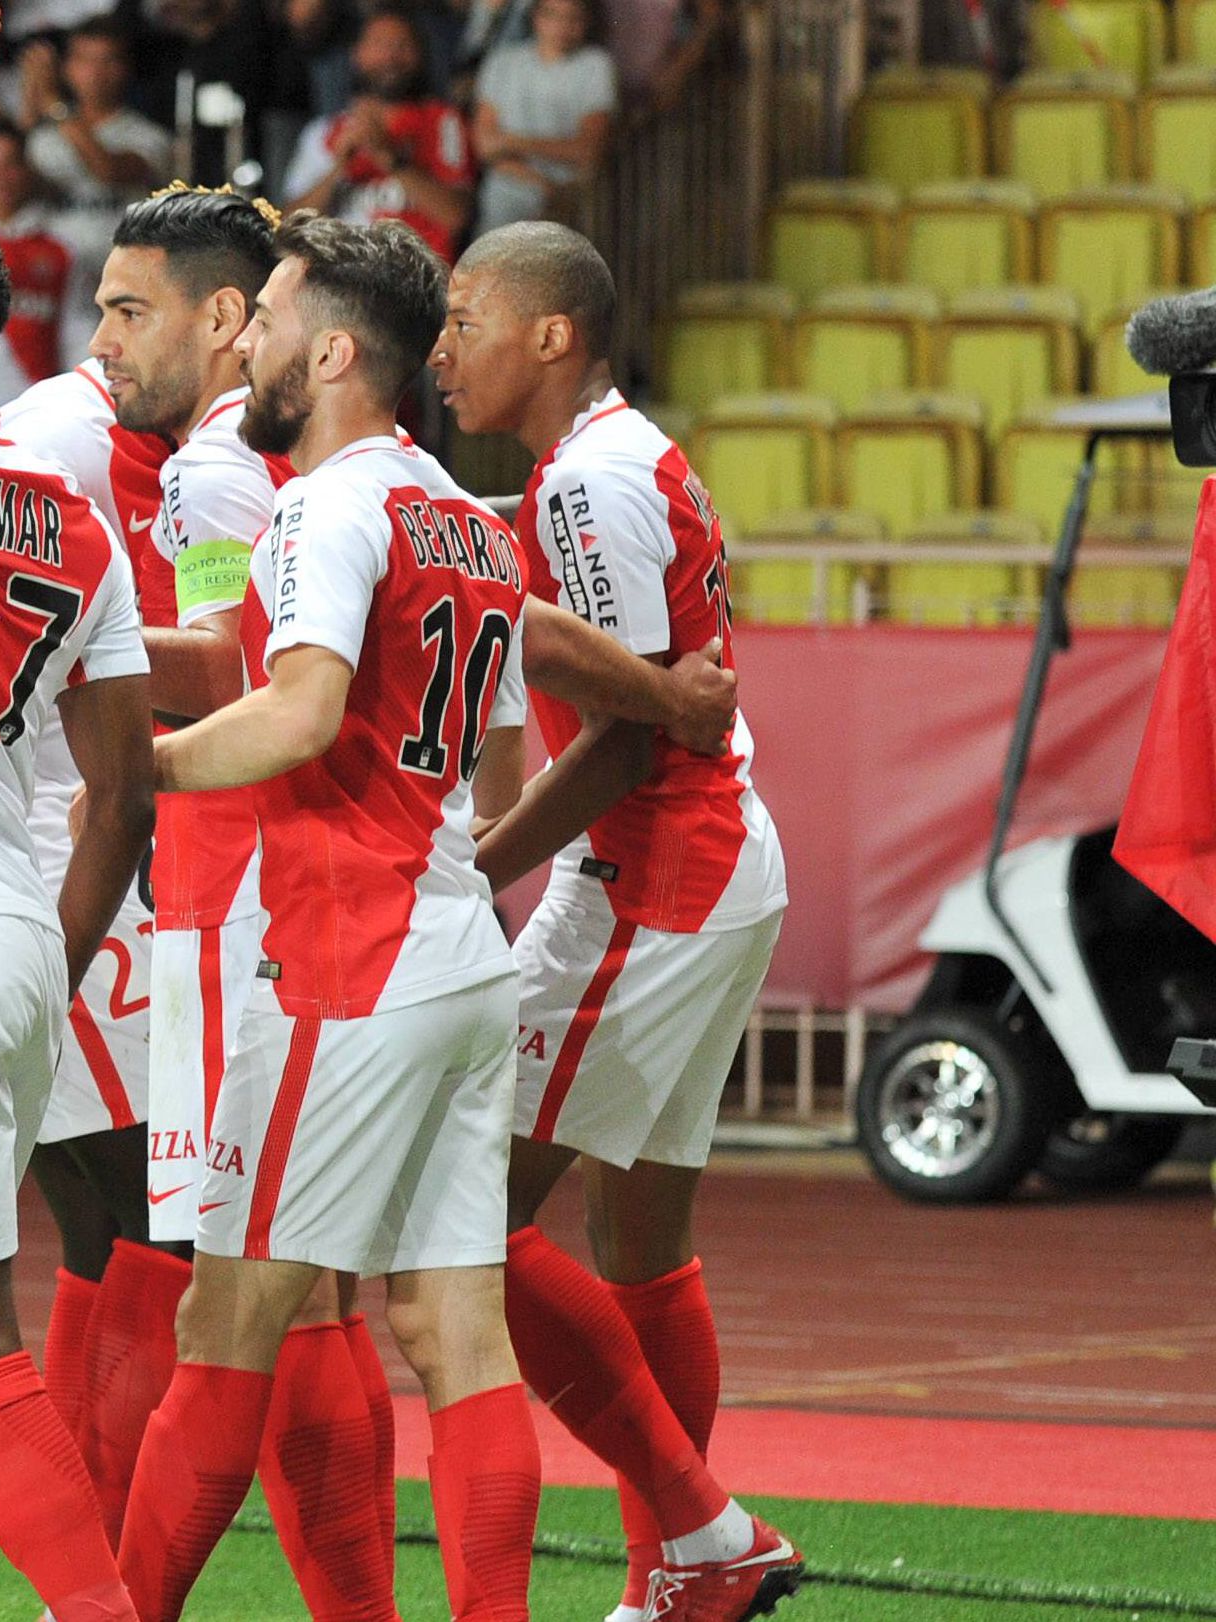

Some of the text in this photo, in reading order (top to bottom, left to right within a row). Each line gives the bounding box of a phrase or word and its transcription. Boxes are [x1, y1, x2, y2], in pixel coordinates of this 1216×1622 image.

[200, 557, 216, 568] TO
[397, 595, 513, 782] 10
[99, 921, 153, 1020] 2
